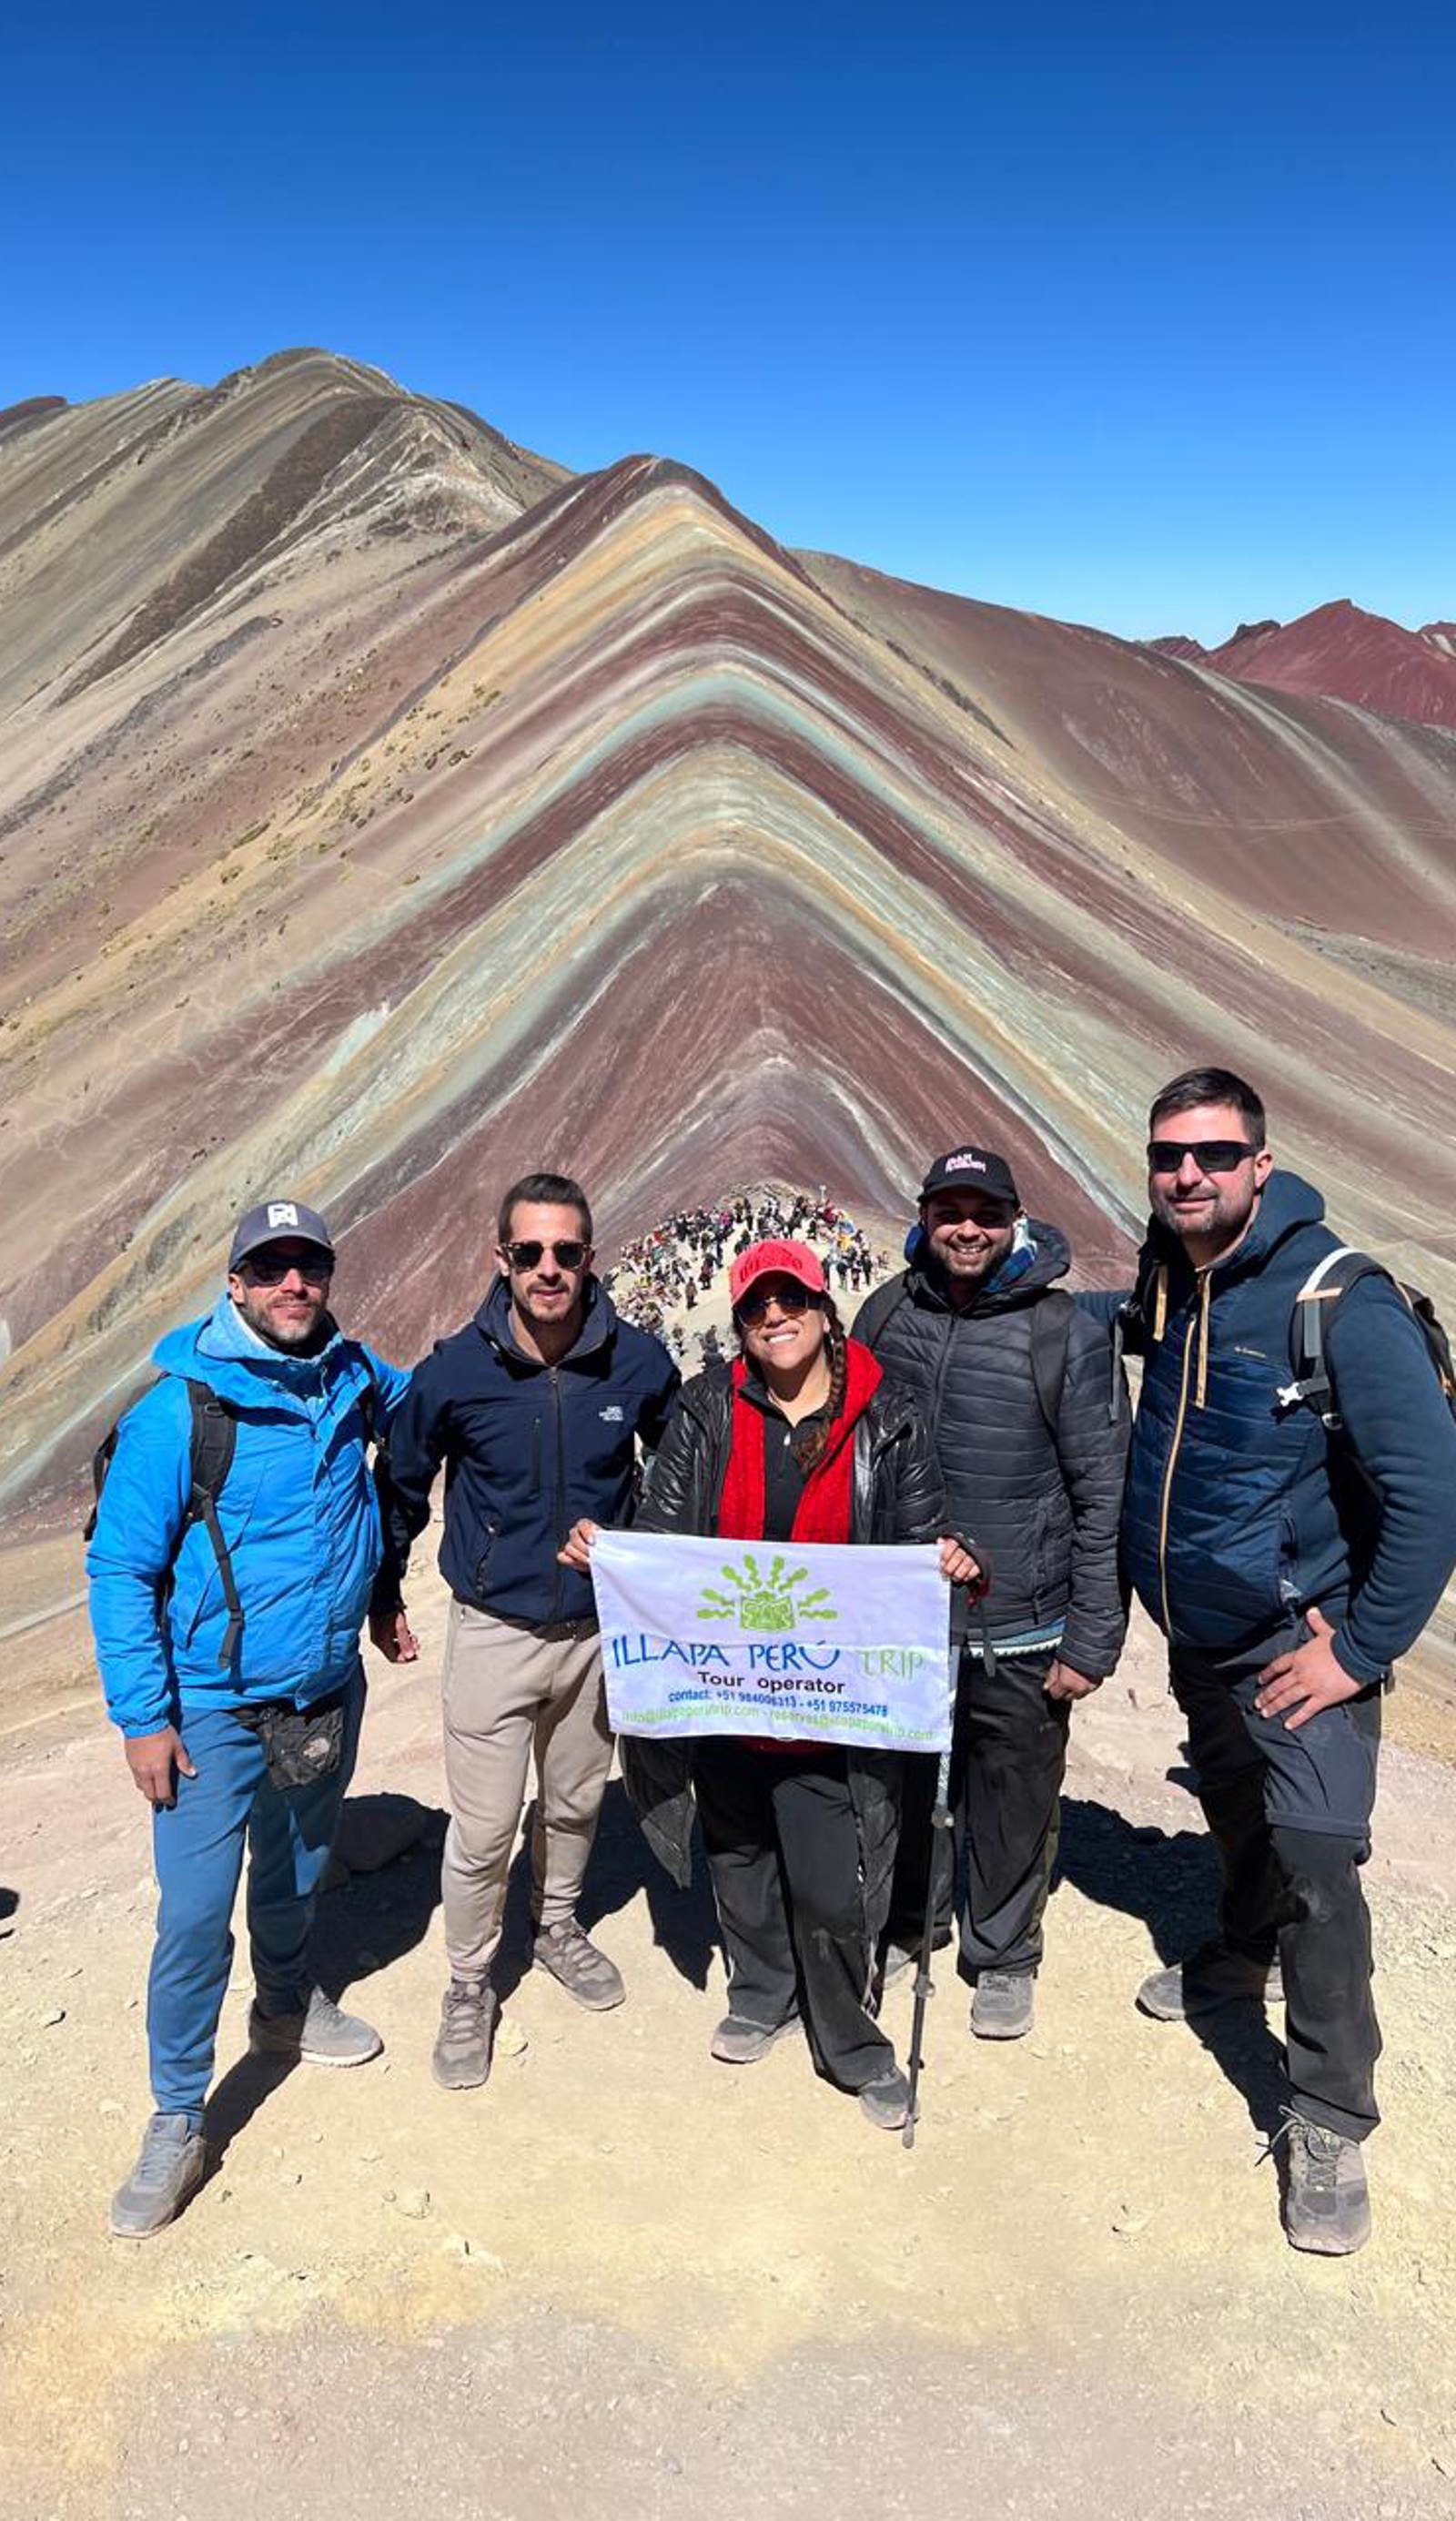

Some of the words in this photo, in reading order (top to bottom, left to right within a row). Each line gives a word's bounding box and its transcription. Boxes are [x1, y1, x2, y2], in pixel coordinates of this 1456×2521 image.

[612, 1633, 730, 1669] ILLAPA
[748, 1640, 841, 1672] PERÚ
[857, 1648, 925, 1680] TRIP
[697, 1671, 745, 1686] Tour
[757, 1677, 845, 1694] operator
[806, 1698, 825, 1712] +51
